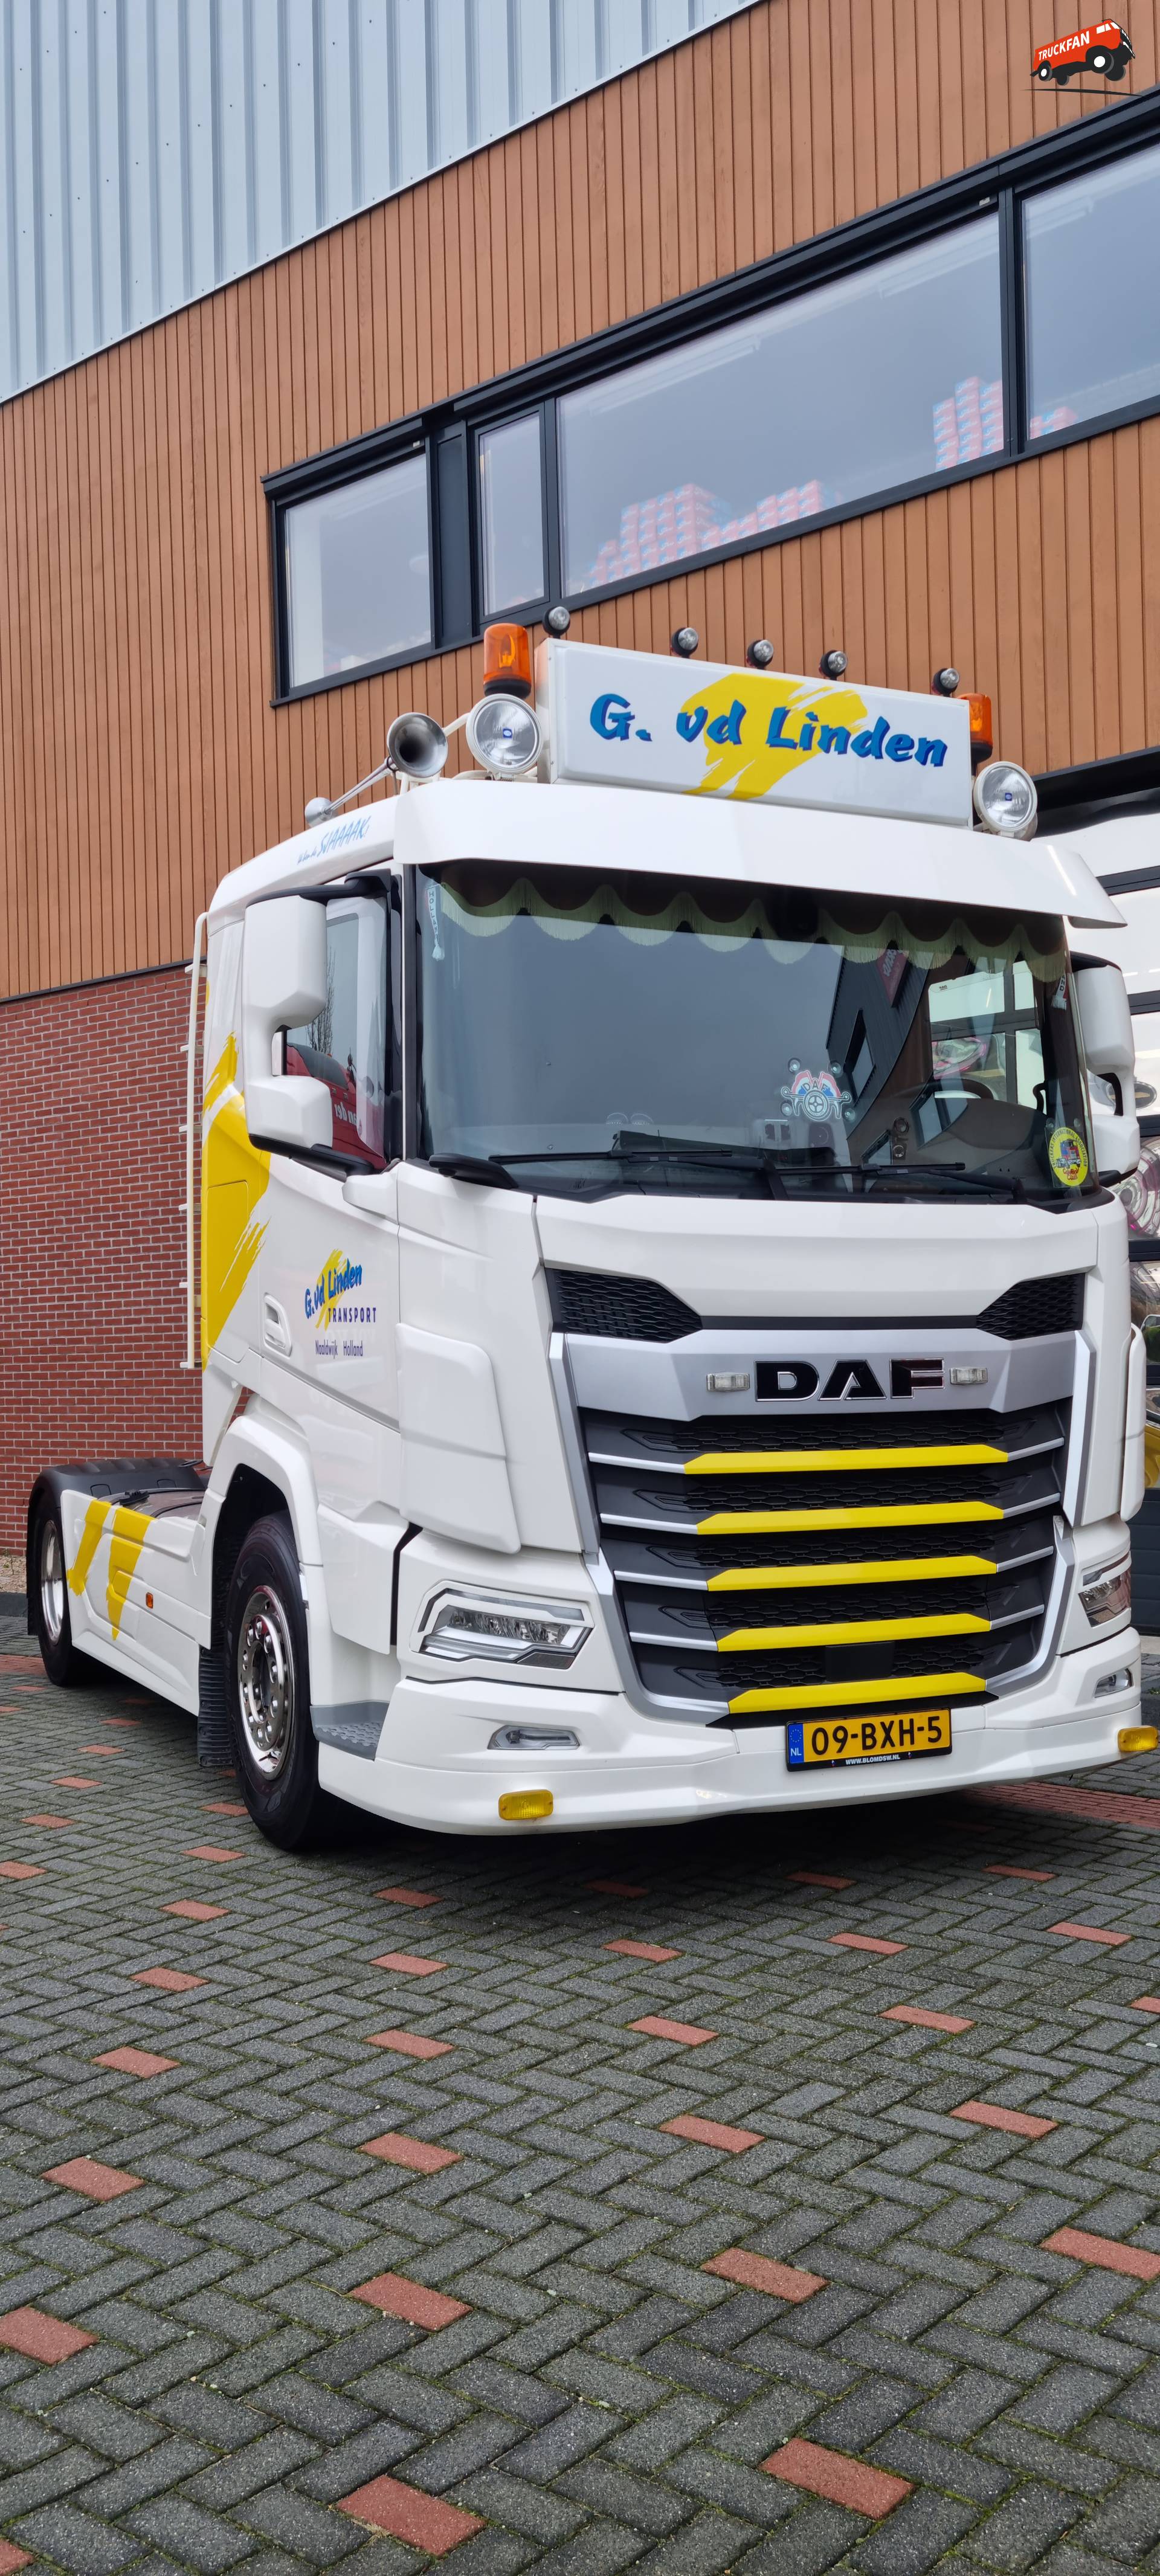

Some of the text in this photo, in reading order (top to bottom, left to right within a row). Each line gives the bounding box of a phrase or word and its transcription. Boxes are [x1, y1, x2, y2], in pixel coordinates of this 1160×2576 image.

[590, 694, 949, 768] G. vd Linden
[802, 1080, 828, 1092] DAF
[328, 1258, 362, 1300] Linden
[328, 1307, 376, 1323] TRANSPORT
[315, 1340, 363, 1359] Naaldwijk Holland
[753, 1357, 946, 1402] DAF
[790, 1716, 942, 1757] NL 09-BXH-5
[846, 1754, 900, 1765] WWW.BLOMDSW.NL
